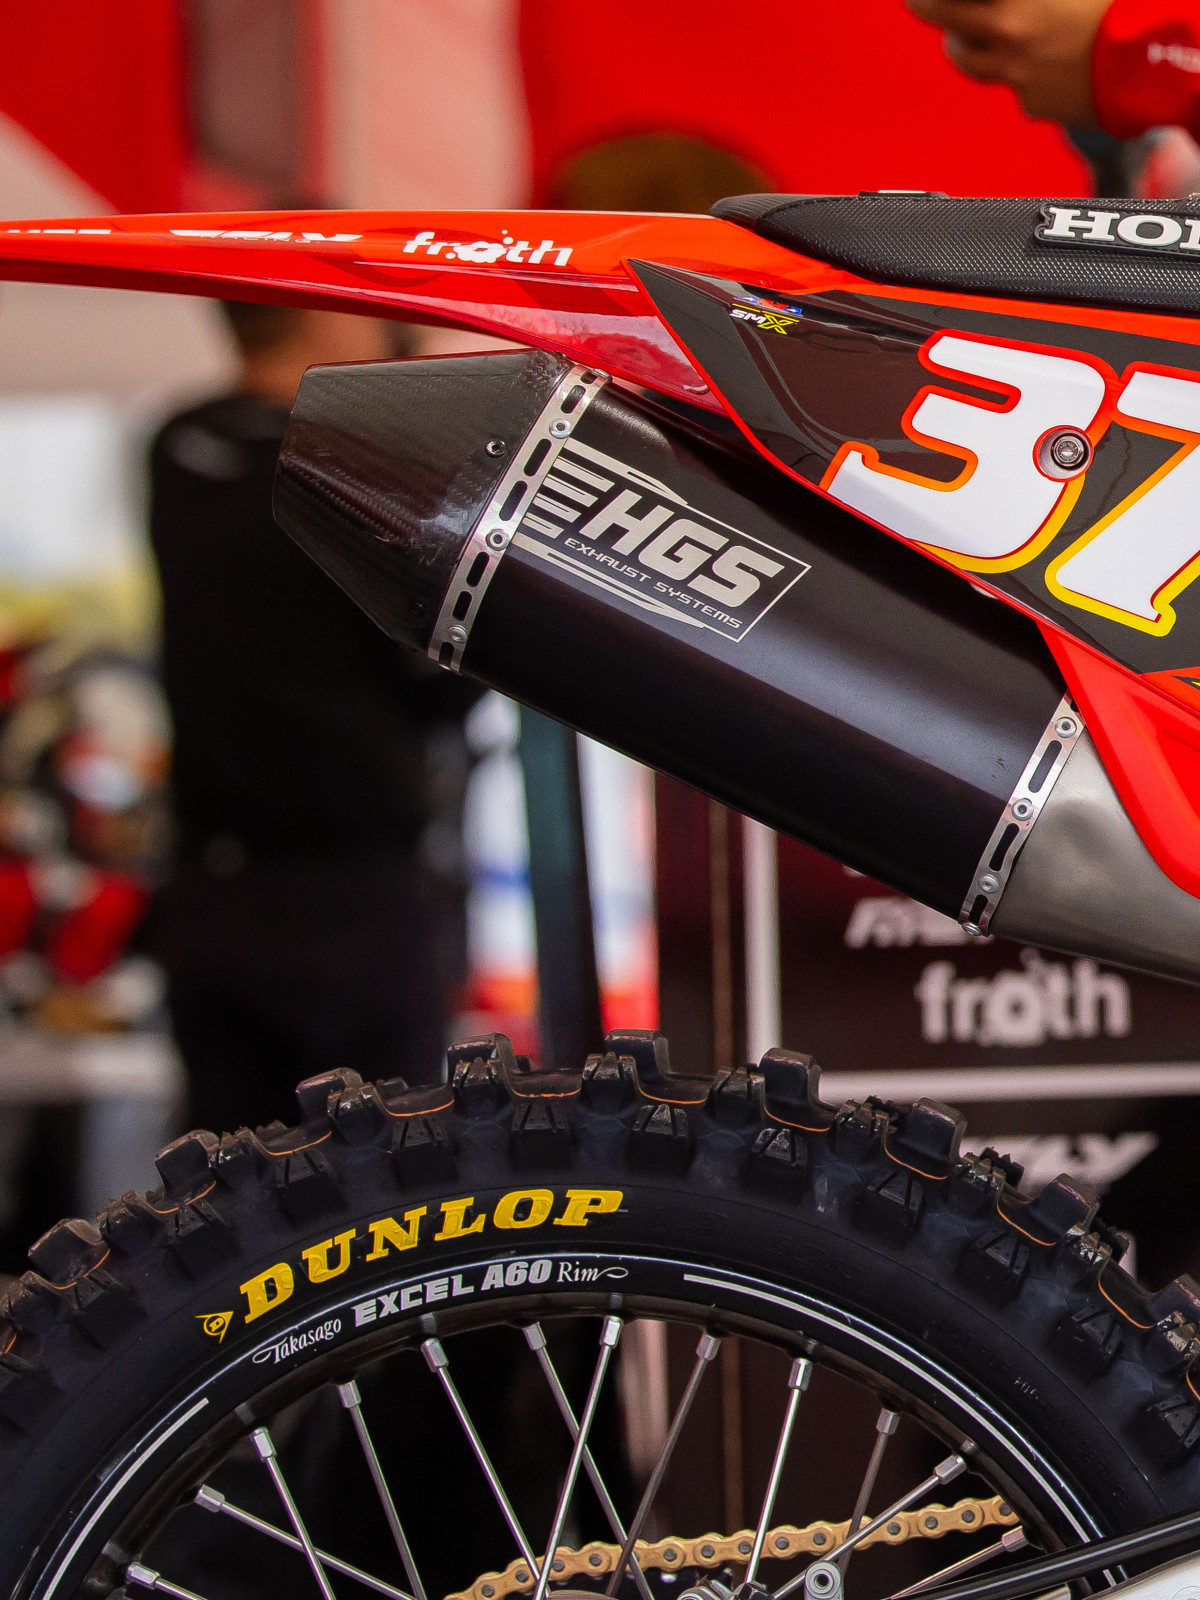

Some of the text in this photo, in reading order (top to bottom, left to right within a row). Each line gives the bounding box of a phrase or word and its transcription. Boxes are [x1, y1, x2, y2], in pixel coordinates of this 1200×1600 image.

[402, 230, 573, 267] froth
[729, 309, 794, 335] SMX
[564, 537, 744, 629] EXHAUST SYSTEMS
[578, 488, 786, 608] HGS
[238, 1188, 624, 1324] DUNLOP
[252, 1259, 629, 1365] Takasago EXCEL A60 Rim
